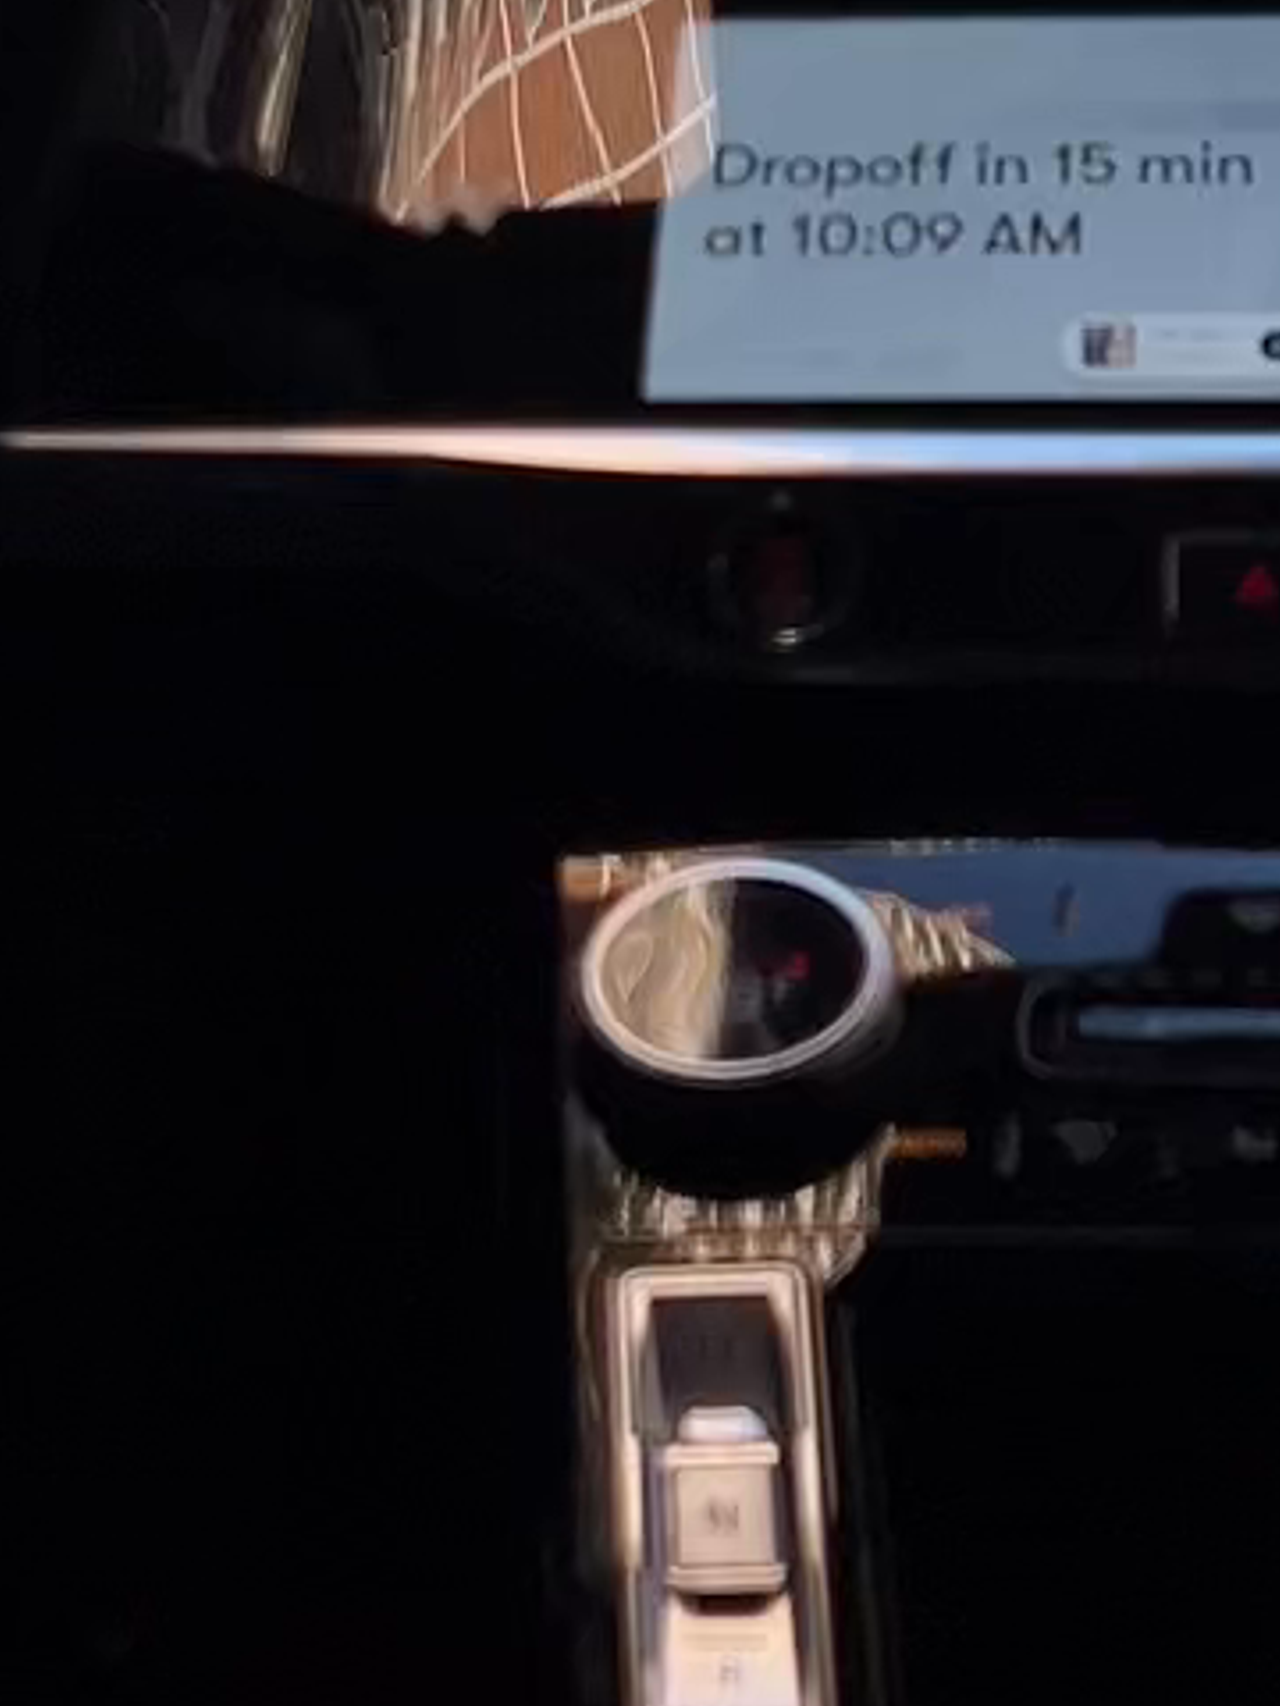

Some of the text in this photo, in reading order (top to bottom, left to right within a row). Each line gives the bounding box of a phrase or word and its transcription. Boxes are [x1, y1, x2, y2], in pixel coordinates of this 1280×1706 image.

[713, 140, 1254, 197] Dropoff in 15 min
[704, 210, 1083, 258] at 10:09 AM
